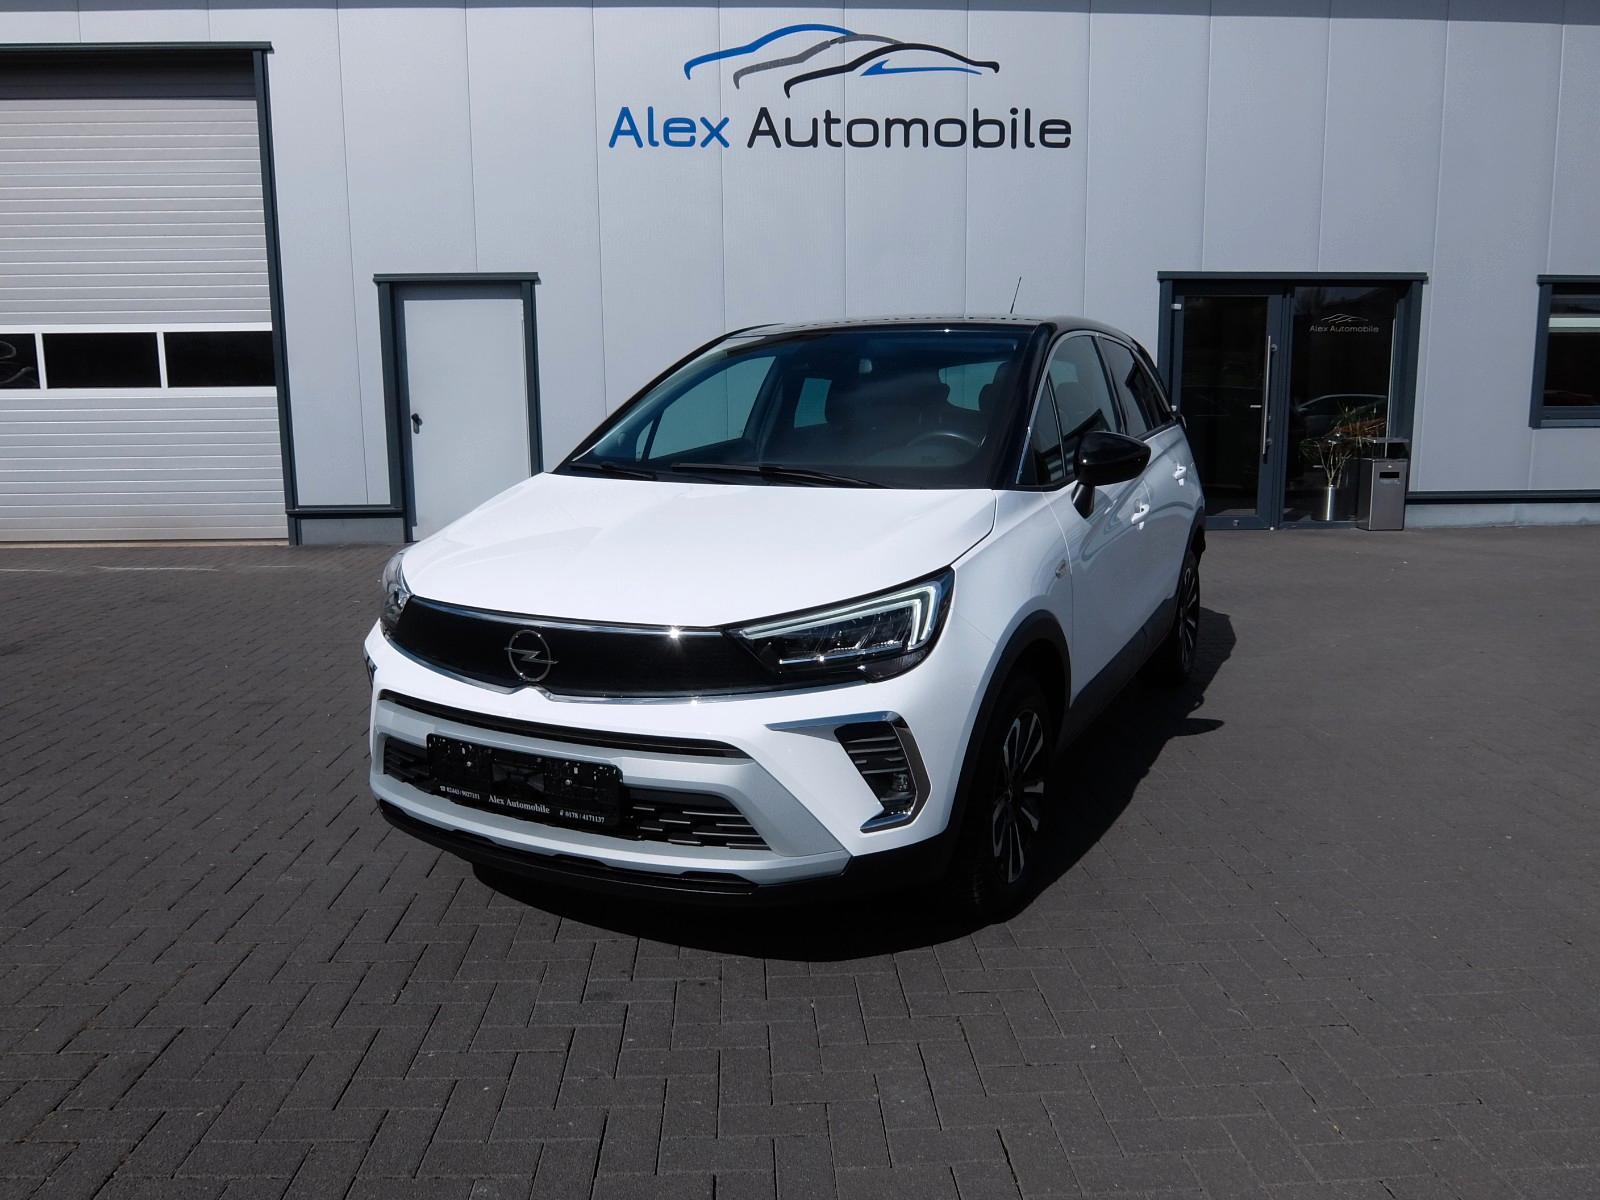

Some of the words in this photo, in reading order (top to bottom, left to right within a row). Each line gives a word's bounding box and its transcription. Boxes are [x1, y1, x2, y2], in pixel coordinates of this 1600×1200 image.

[609, 106, 730, 149] Alex
[747, 106, 1072, 149] Automobile
[1309, 324, 1328, 333] Alex
[1330, 324, 1379, 333] Automobile
[488, 794, 505, 805] Alex
[506, 798, 551, 814] Automobile
